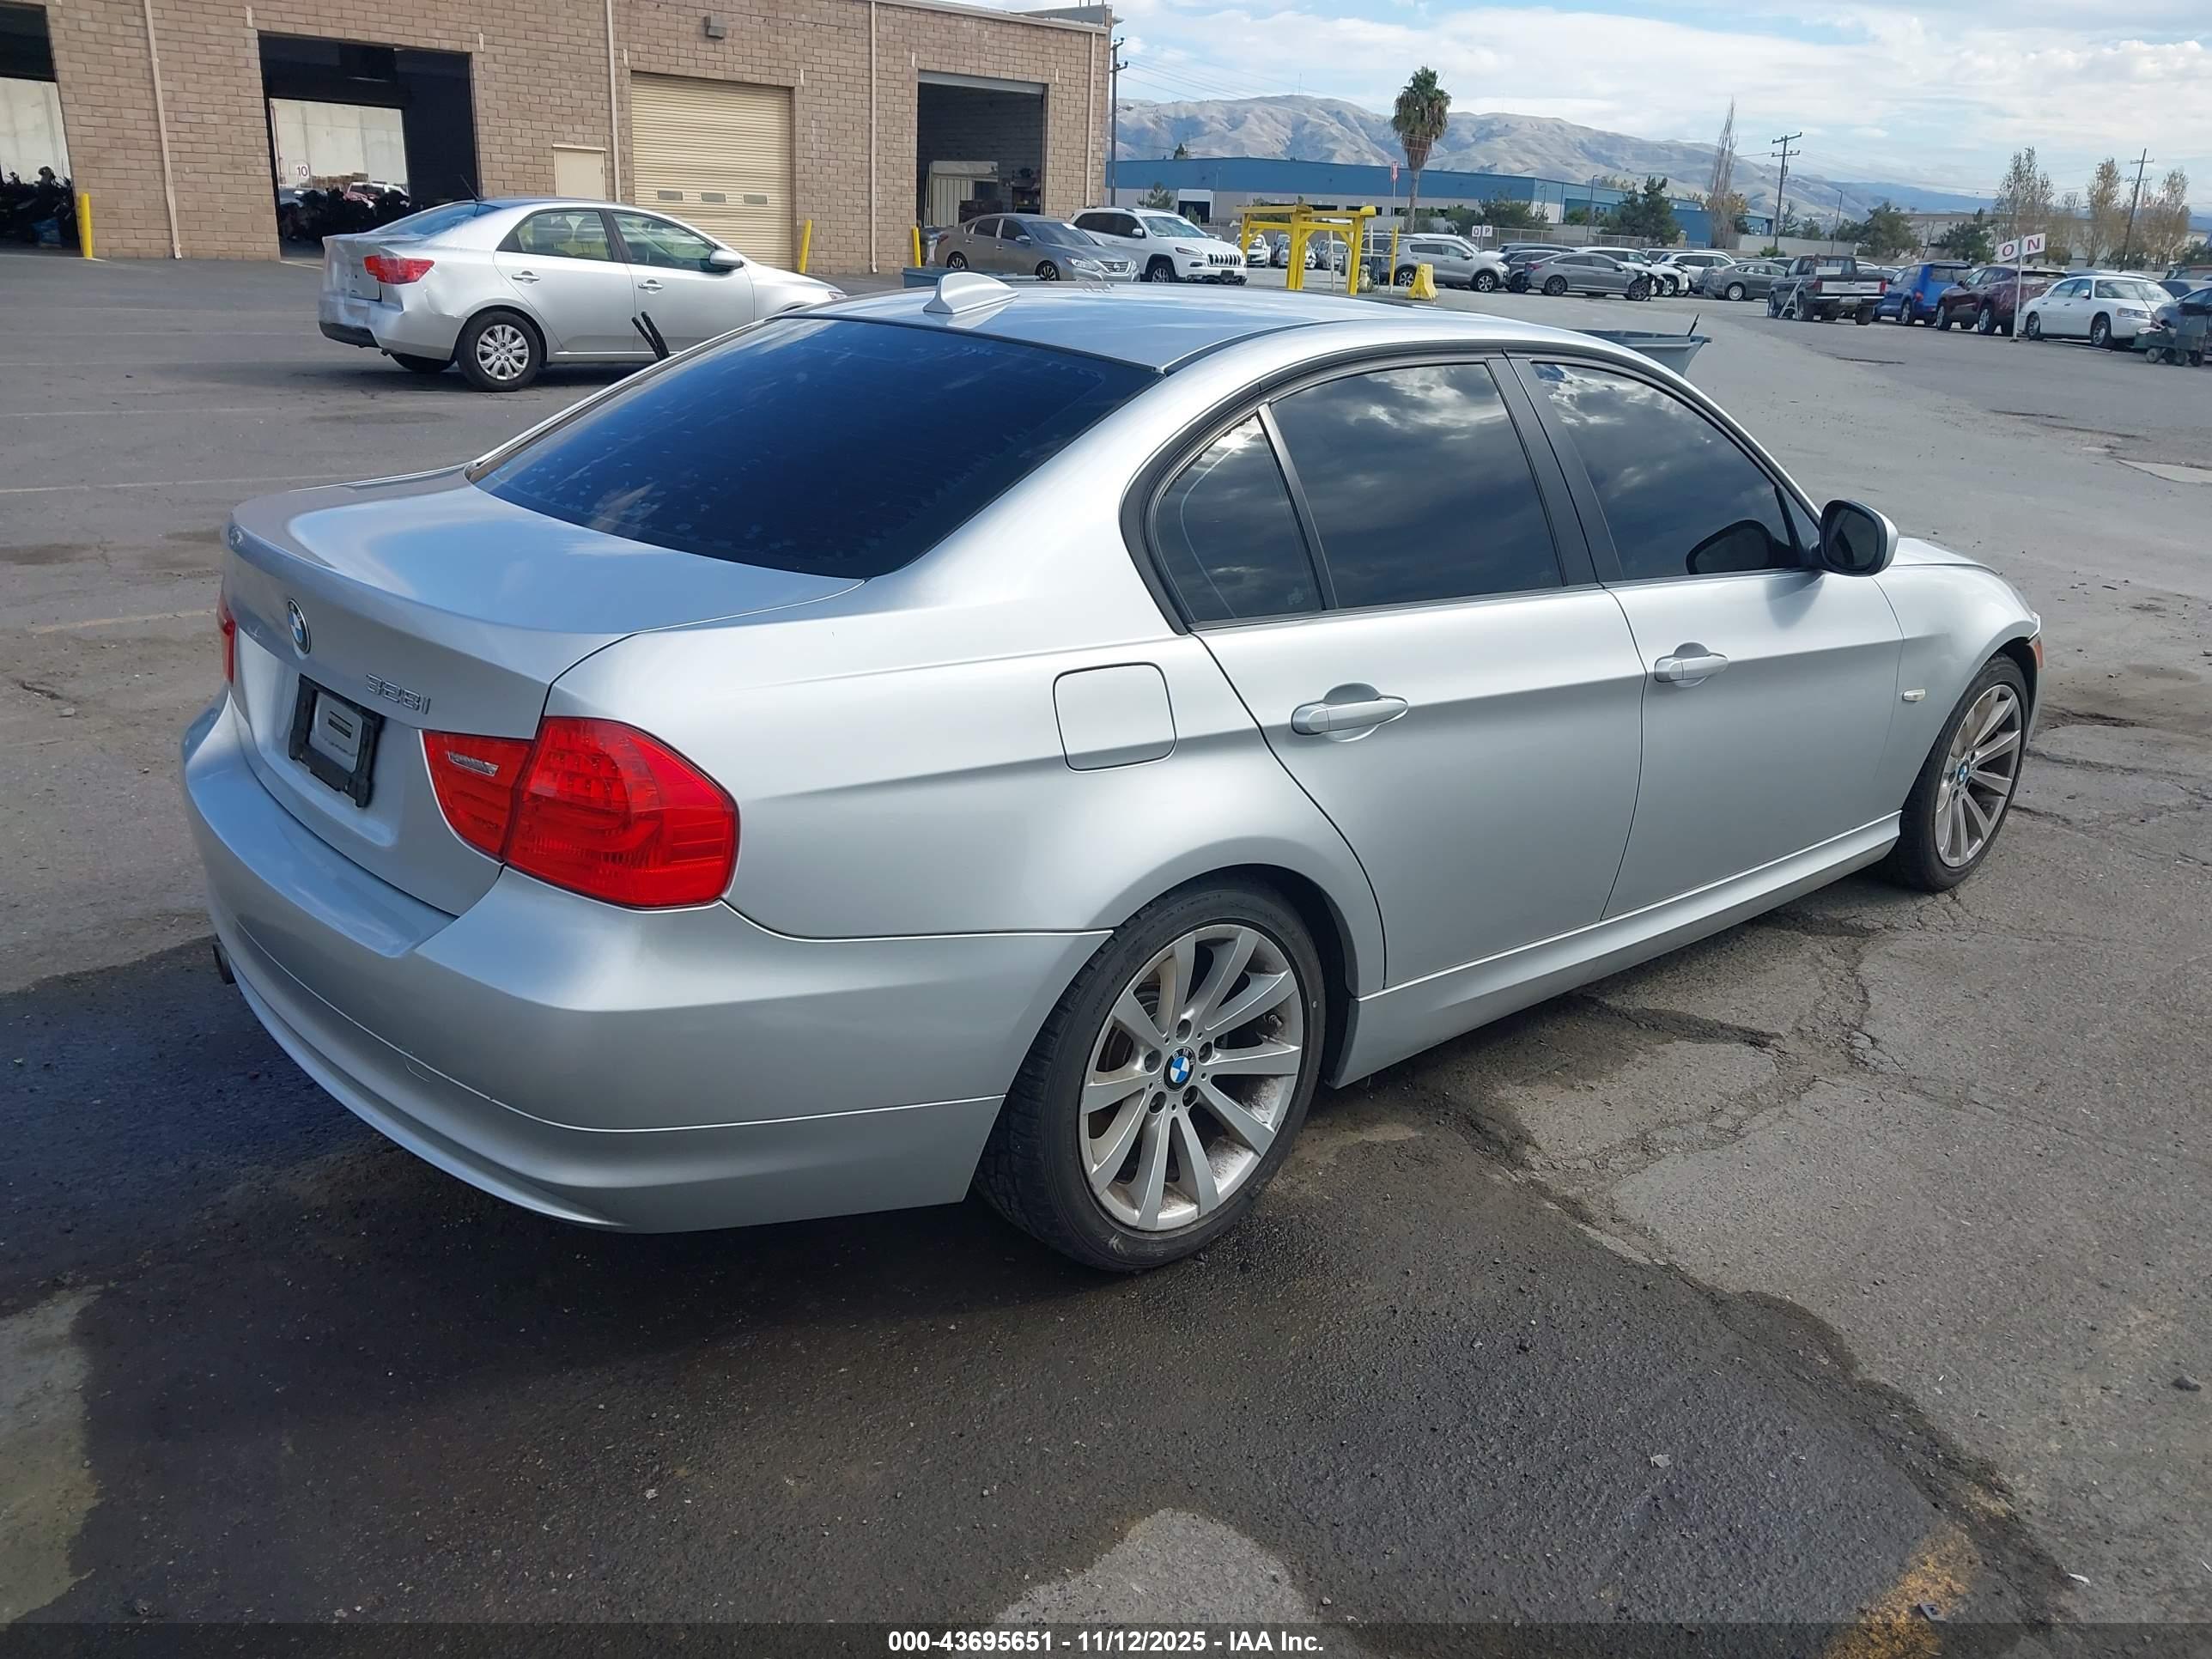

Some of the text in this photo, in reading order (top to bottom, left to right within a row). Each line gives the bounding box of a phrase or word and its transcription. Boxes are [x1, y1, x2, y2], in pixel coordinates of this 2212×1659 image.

[296, 166, 307, 177] 10
[2002, 244, 2014, 257] O
[2027, 237, 2040, 251] N
